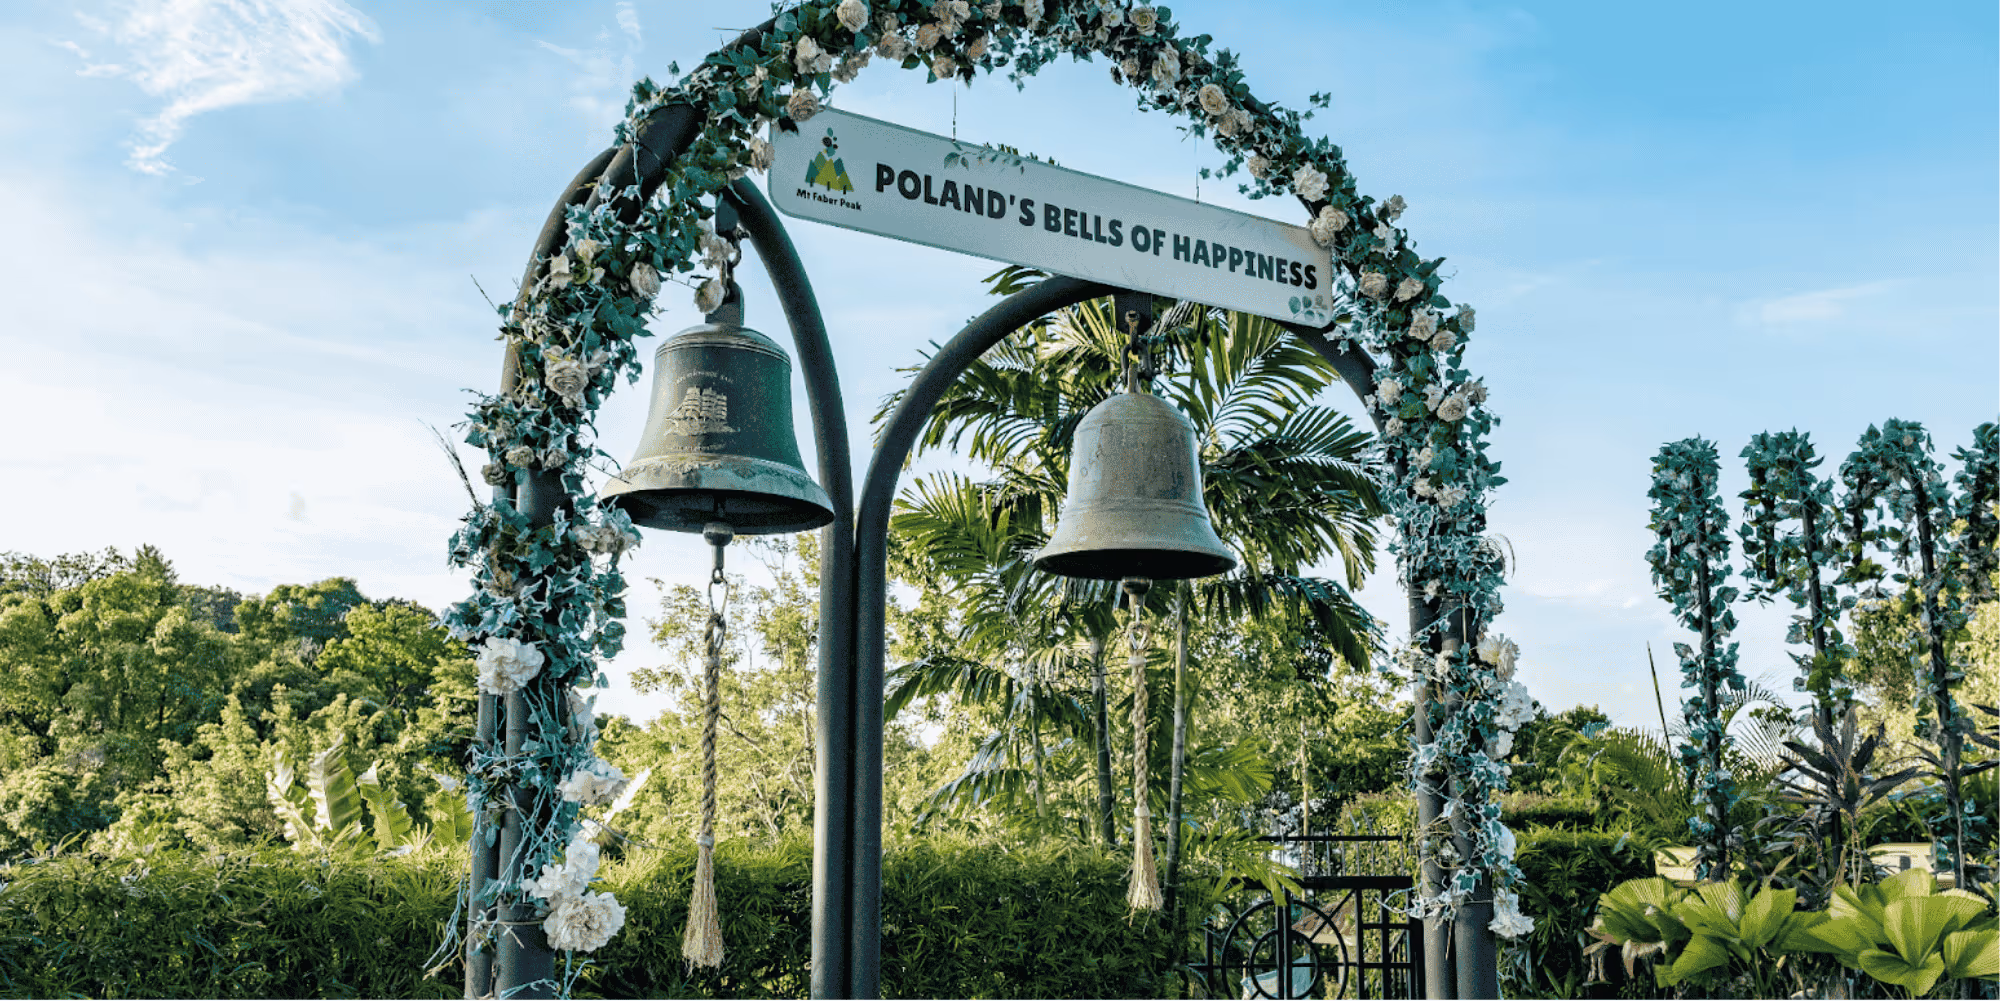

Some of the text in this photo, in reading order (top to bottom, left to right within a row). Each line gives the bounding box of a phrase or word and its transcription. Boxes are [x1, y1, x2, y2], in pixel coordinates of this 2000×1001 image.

[796, 188, 861, 211] Mt Faber Peak
[876, 162, 1317, 290] POLAND'S BELLS OF HAPPINESS
